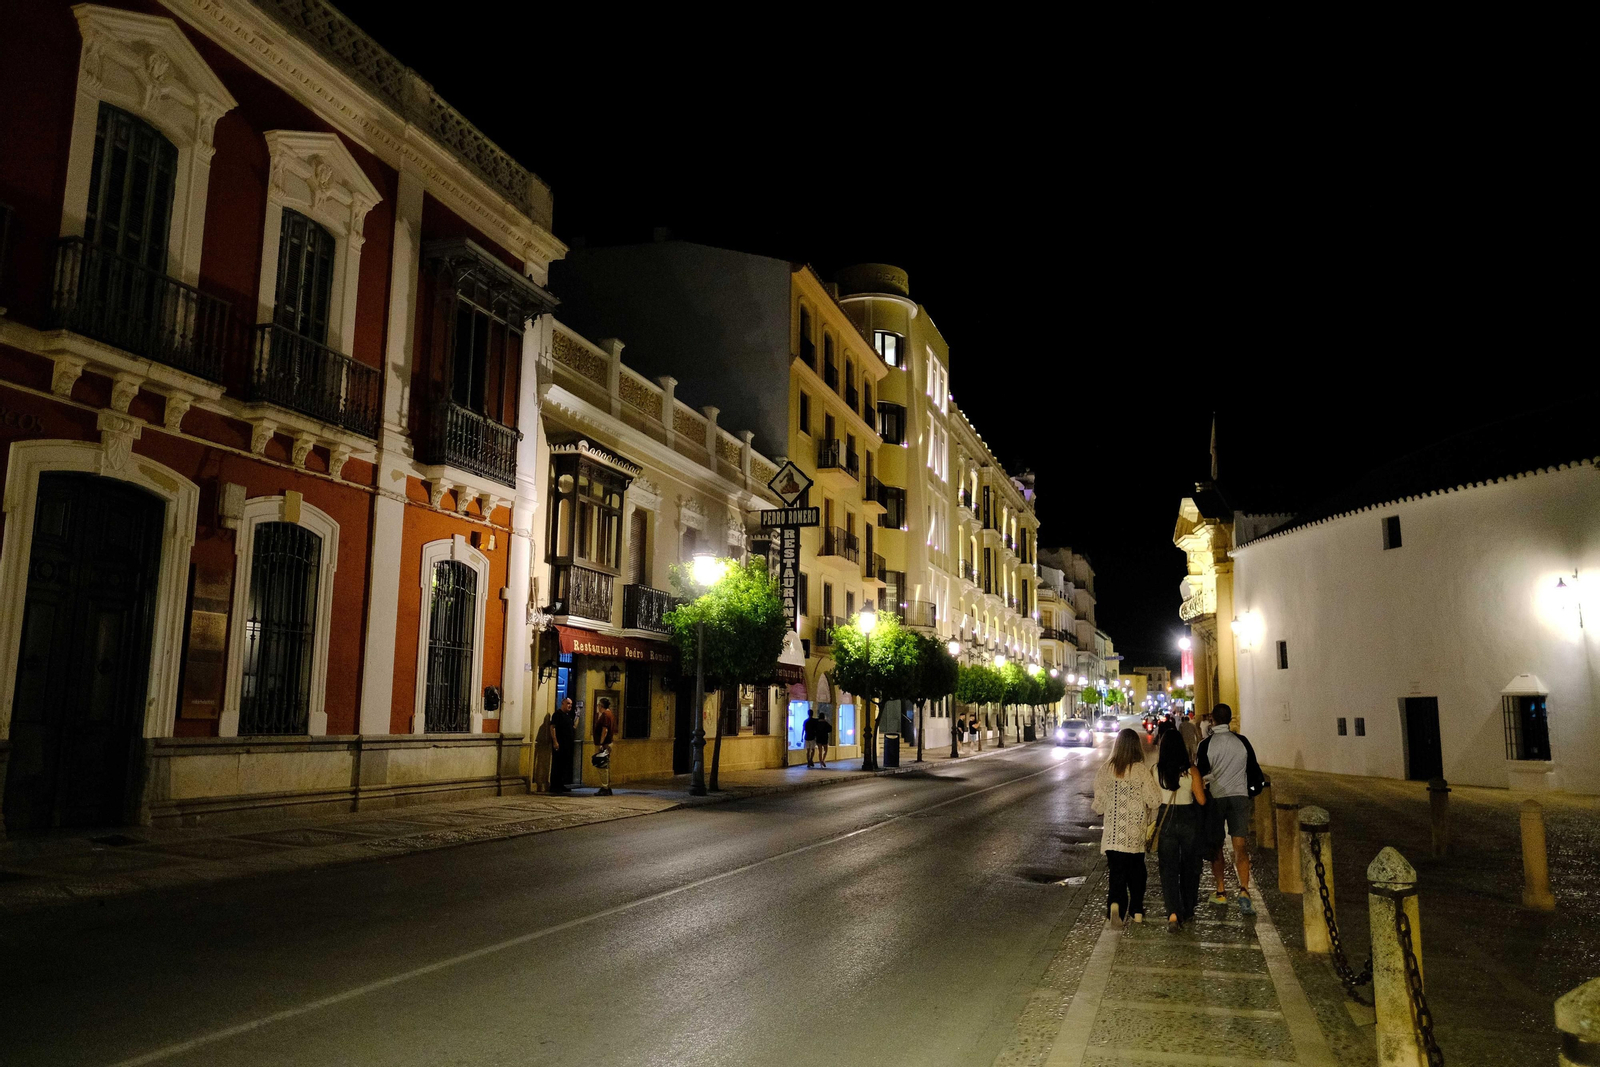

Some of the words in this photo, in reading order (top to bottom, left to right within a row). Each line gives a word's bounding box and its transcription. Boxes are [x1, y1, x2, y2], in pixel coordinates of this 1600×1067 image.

[762, 511, 786, 526] PEDRO
[788, 509, 817, 525] ROMERO
[573, 639, 619, 656] Restaurante
[625, 646, 644, 659] Pedro
